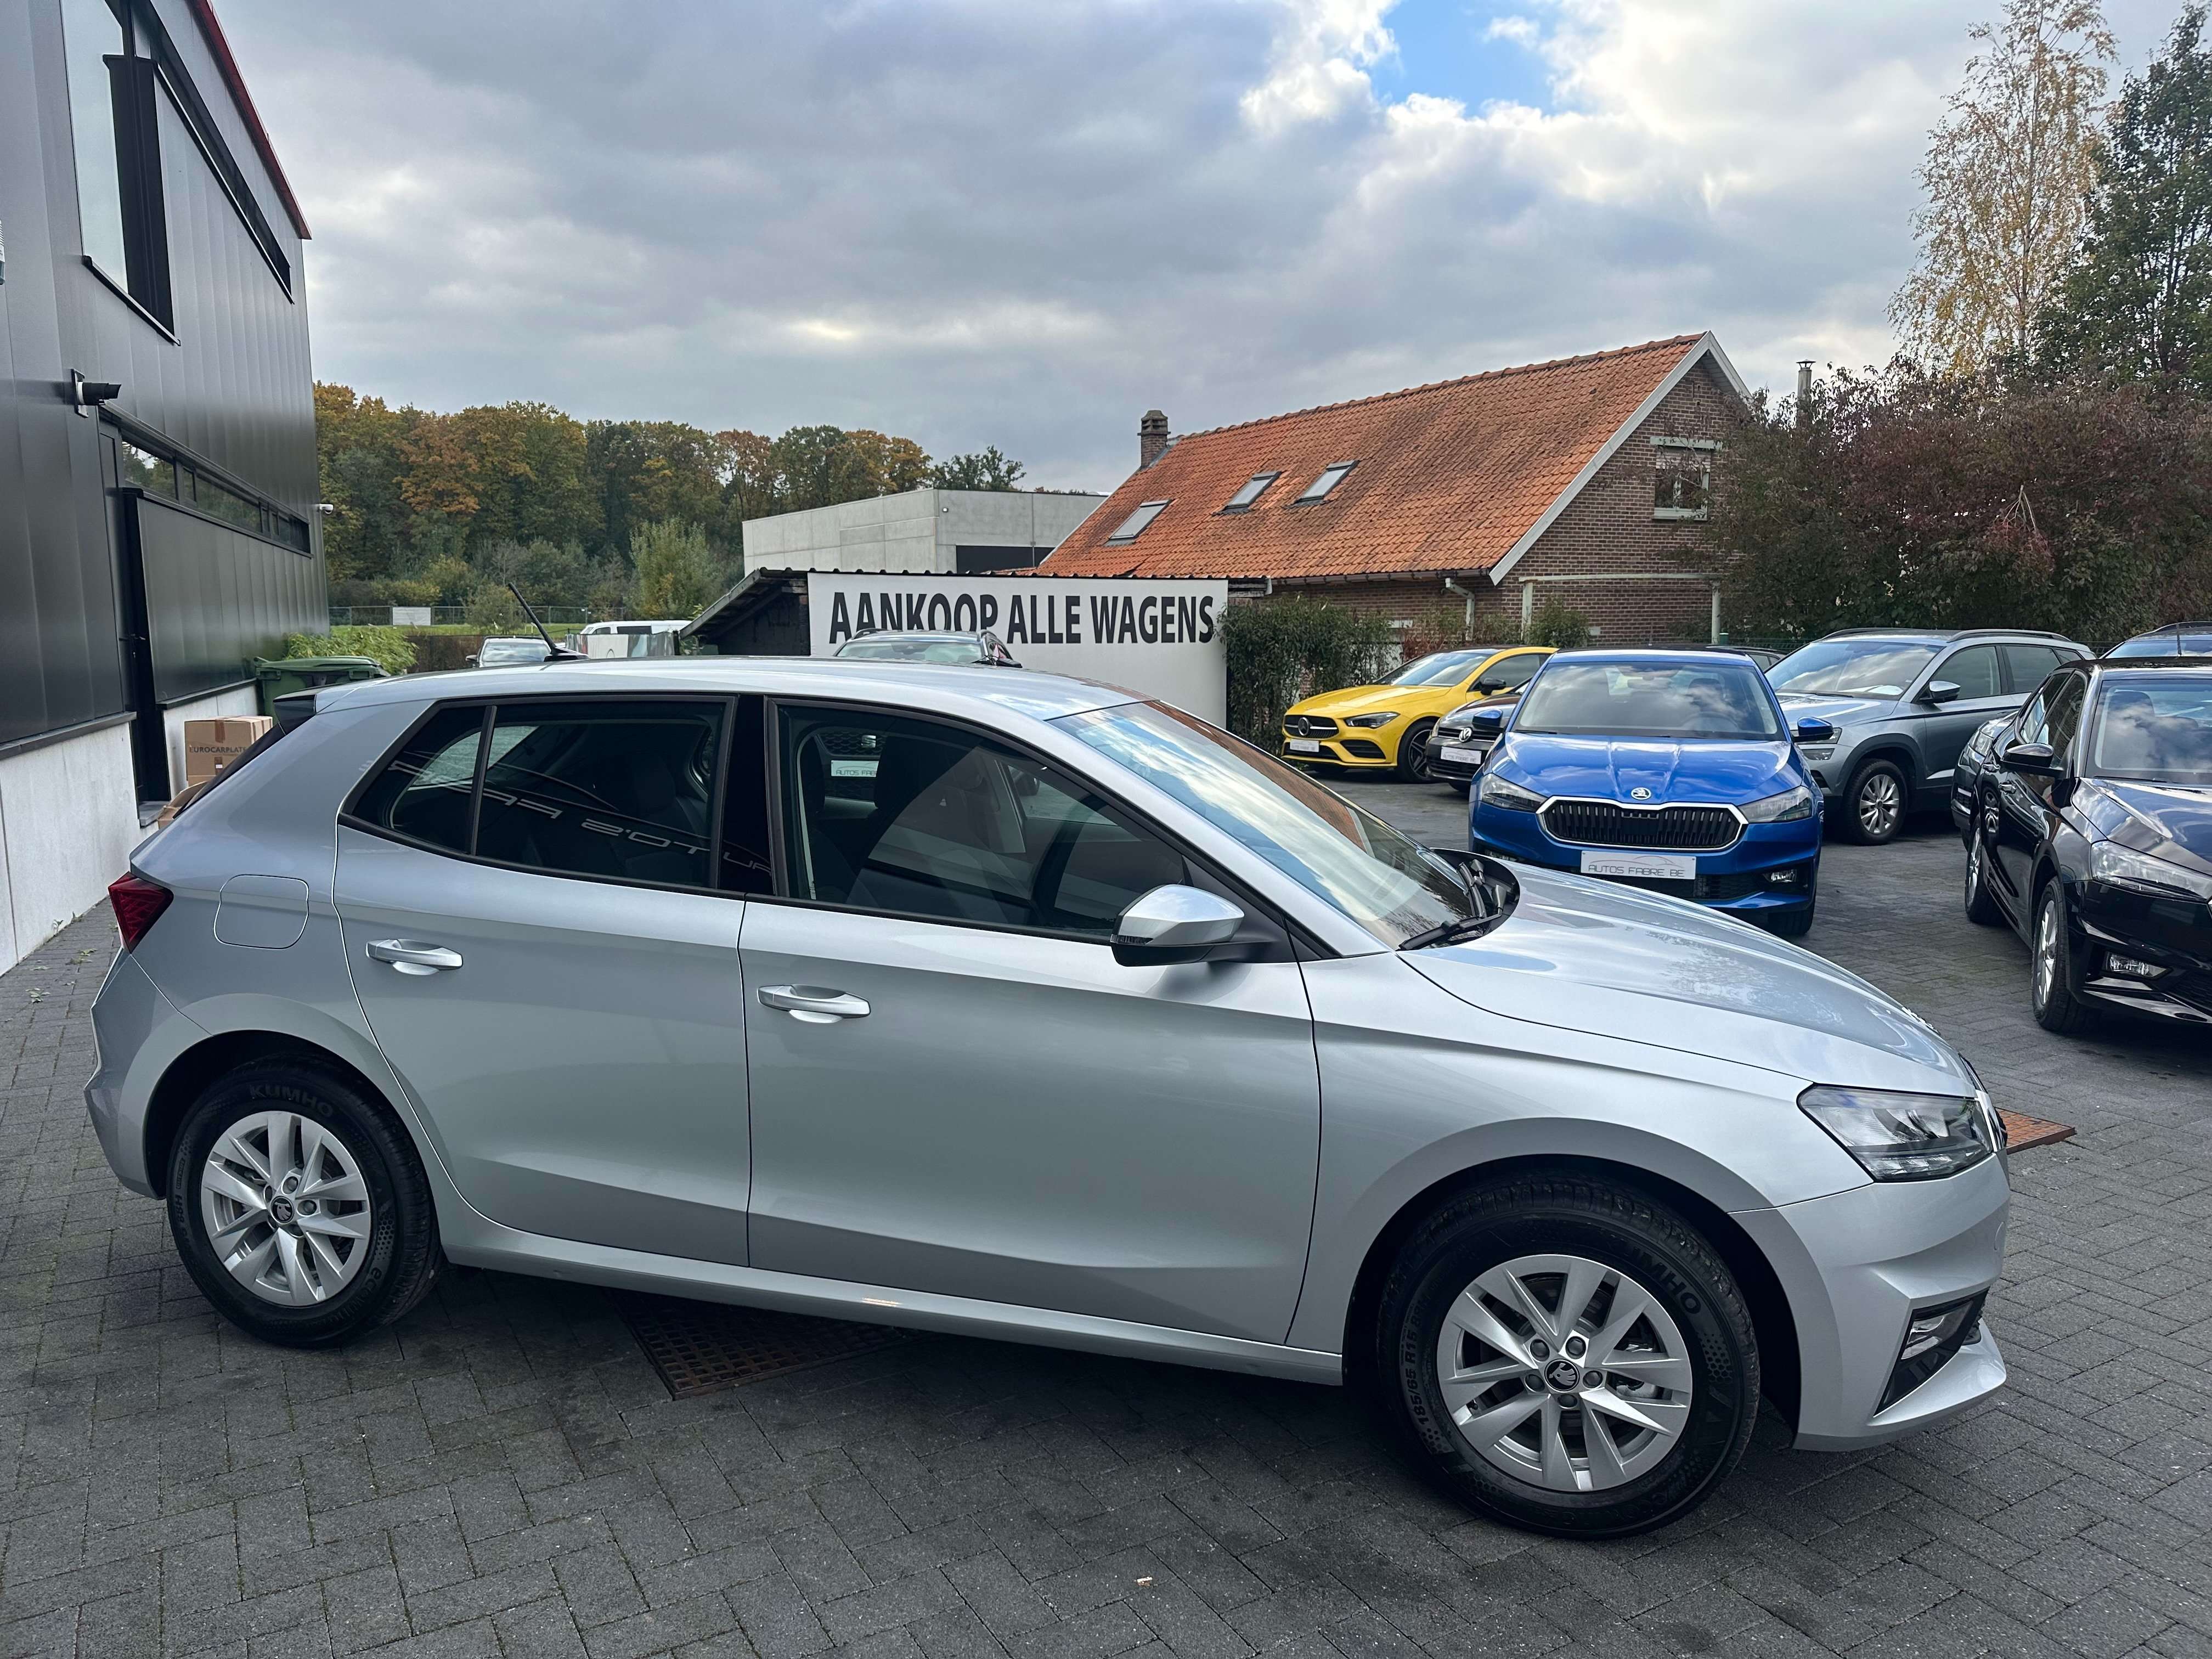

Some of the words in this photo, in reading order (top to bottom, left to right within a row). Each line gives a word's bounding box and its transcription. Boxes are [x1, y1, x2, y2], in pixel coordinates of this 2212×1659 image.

[829, 592, 998, 644] AANKOOP
[1007, 594, 1081, 645] ALLE
[1090, 595, 1214, 644] WAGENS
[1588, 864, 1624, 874] AUTOS
[1628, 867, 1665, 877] FABRE
[1670, 869, 1685, 878] BE
[1404, 1330, 1418, 1364] R15
[1404, 1368, 1430, 1426] 185/65
